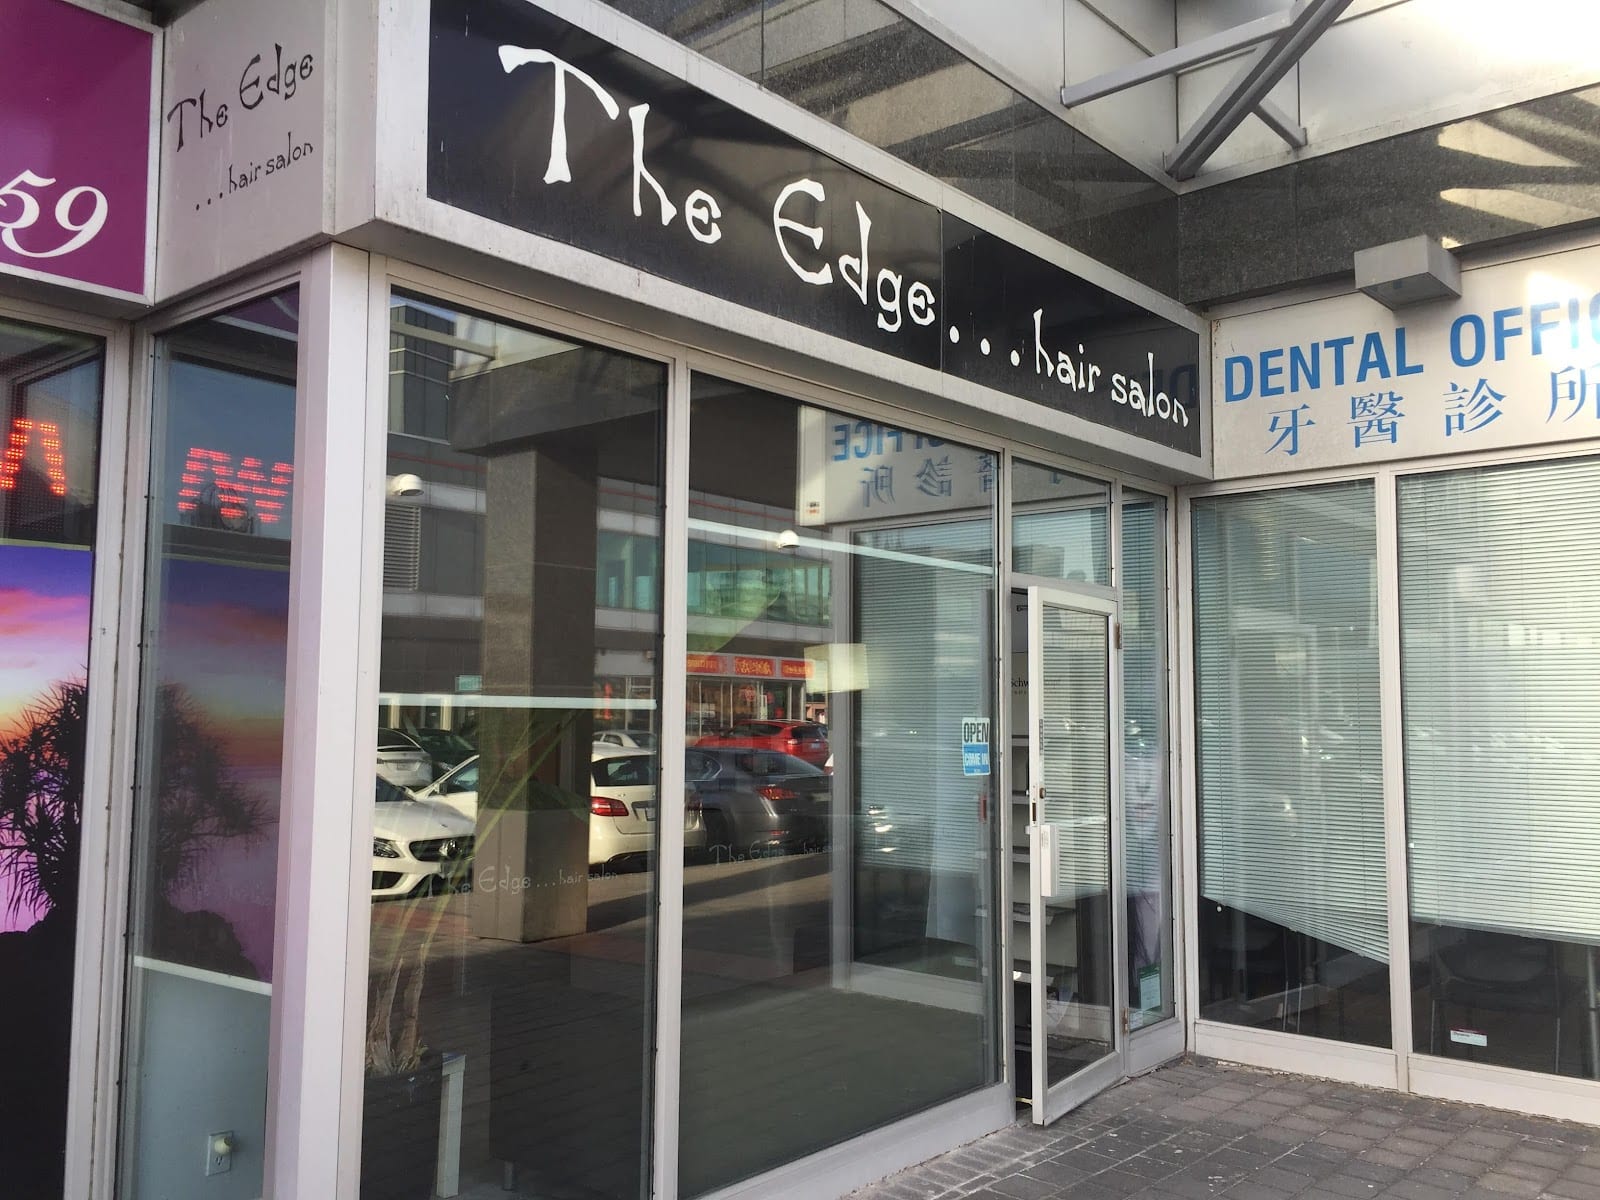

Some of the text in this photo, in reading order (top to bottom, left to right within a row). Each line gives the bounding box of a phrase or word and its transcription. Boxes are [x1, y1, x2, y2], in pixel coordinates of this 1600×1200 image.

[168, 43, 314, 152] The Edge
[265, 132, 314, 176] salon
[0, 169, 108, 258] 59
[498, 45, 722, 245] The
[1111, 352, 1189, 427] salon
[1224, 327, 1424, 403] DENTAL
[964, 722, 989, 743] OPEN
[478, 865, 531, 894] Edge
[709, 842, 745, 866] The
